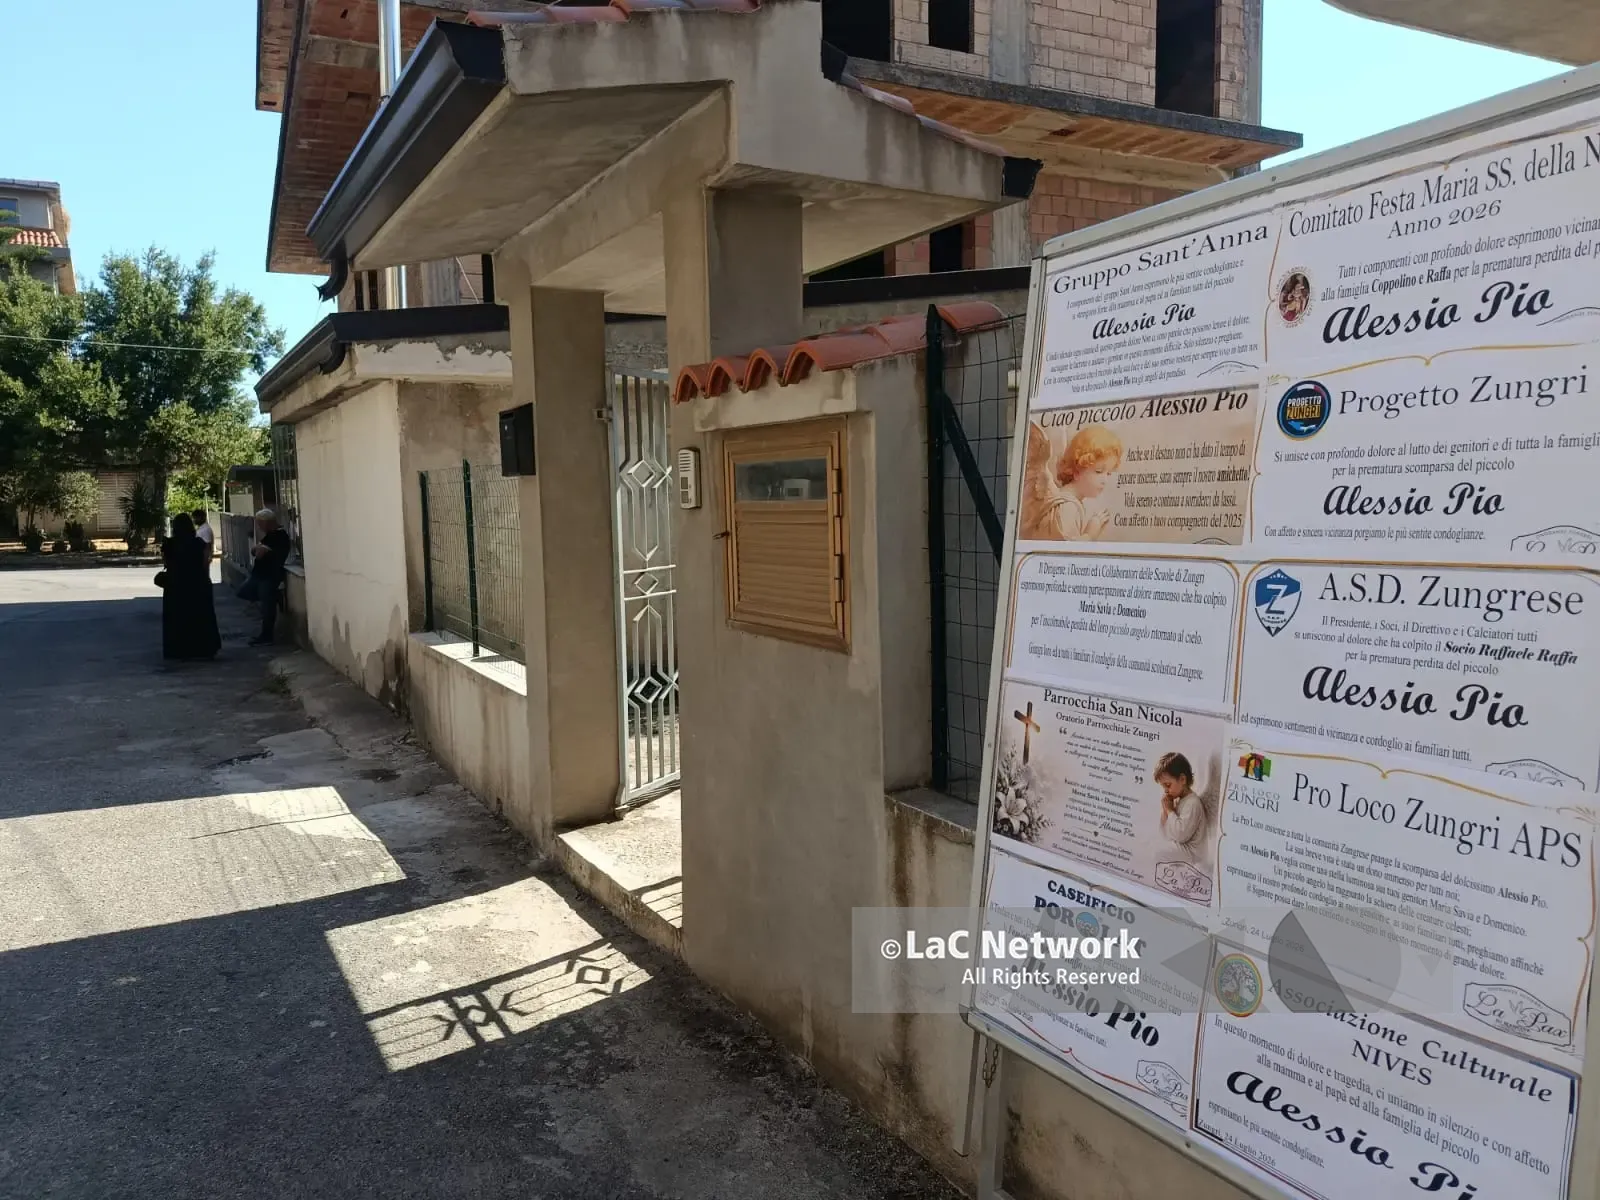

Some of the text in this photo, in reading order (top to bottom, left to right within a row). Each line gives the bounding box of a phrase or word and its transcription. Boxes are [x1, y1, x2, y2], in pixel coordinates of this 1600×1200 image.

[1290, 201, 1363, 236] Comitato
[1368, 188, 1416, 218] Festa
[1420, 171, 1478, 205] Maria
[1484, 159, 1516, 191] SS.
[1524, 146, 1575, 181] della
[1387, 200, 1502, 239] Anno 2026
[1054, 261, 1131, 293] Gruppo
[1138, 225, 1268, 270] Sant'Anna
[1363, 252, 1411, 275] componenti
[1413, 252, 1429, 265] con
[1431, 241, 1473, 265] profondo
[1474, 236, 1504, 253] dolore
[1507, 227, 1562, 248] esprimono
[1371, 274, 1417, 295] Coppolino
[1426, 266, 1451, 282] Raffa
[1453, 266, 1470, 282] per
[1471, 261, 1480, 274] la
[1482, 254, 1532, 277] prematura
[1535, 246, 1571, 267] perdita
[1574, 240, 1592, 255] del
[1092, 303, 1196, 340] Alessio Pio
[1322, 281, 1554, 344] Alessio Pio
[1040, 392, 1248, 430] Ciao piccolo Alessio Pio
[1286, 394, 1322, 420] PROGETTO ZUNGRI
[1338, 367, 1588, 420] Progetto Zungri
[1310, 451, 1326, 461] con
[1327, 446, 1366, 464] profondo
[1367, 445, 1396, 458] dolore
[1398, 444, 1407, 456] al
[1409, 444, 1431, 456] lutto
[1433, 442, 1448, 455] dei
[1450, 440, 1490, 458] genitori
[1502, 438, 1512, 451] di
[1516, 439, 1540, 451] tutta
[1544, 436, 1554, 450] la
[1332, 457, 1515, 480] per la prematura scomparsa del piccolo
[1323, 483, 1504, 516] Alessio Pio
[1318, 571, 1585, 623] A.S.D. Zungrese
[1338, 632, 1578, 664] al dolore che ha colpito il Socio Raffaele Raffa
[1379, 619, 1400, 634] Soci,
[1402, 621, 1409, 632] il
[1411, 622, 1451, 636] Direttivo
[1467, 626, 1514, 641] Calciatori
[1517, 631, 1538, 642] tutti
[1345, 651, 1499, 675] per la prematura perdita del piccolo
[1043, 688, 1183, 727] Parrocchia San Nicola
[1303, 665, 1529, 729] Alessio Pio
[1055, 711, 1085, 725] Oratorio
[1086, 718, 1131, 735] Parrocchiale
[1132, 727, 1160, 743] Zungri
[1366, 736, 1450, 759] cordoglio ai familiari
[1228, 789, 1278, 812] ZUNGRI
[1293, 773, 1582, 868] Pro Loco Zungri APS
[1047, 879, 1136, 925] CASEIFICIO
[1402, 861, 1440, 879] scomparsa
[1441, 869, 1452, 882] del
[1453, 873, 1495, 894] dolcissimo
[1497, 885, 1529, 903] Alessio
[1530, 894, 1548, 909] Pio.
[1452, 954, 1478, 971] grande
[1466, 943, 1508, 964] preghiamo
[1104, 999, 1159, 1046] Pio
[1268, 977, 1552, 1103] Associazione Culturale
[1351, 1038, 1432, 1088] NIVES
[1226, 1070, 1394, 1170] Alessio
[1249, 1032, 1550, 1175] momento di dolore e tragedia, ci uniamo in silenzio e con affetto
[1256, 1054, 1272, 1069] alla
[1272, 1062, 1306, 1085] mamma
[1315, 1080, 1324, 1094] al
[1325, 1086, 1347, 1106] papà
[1348, 1096, 1360, 1110] ed
[1362, 1102, 1380, 1119] alla
[1382, 1109, 1421, 1138] famiglia
[1424, 1127, 1440, 1147] del
[1441, 1138, 1480, 1165] piccolo
